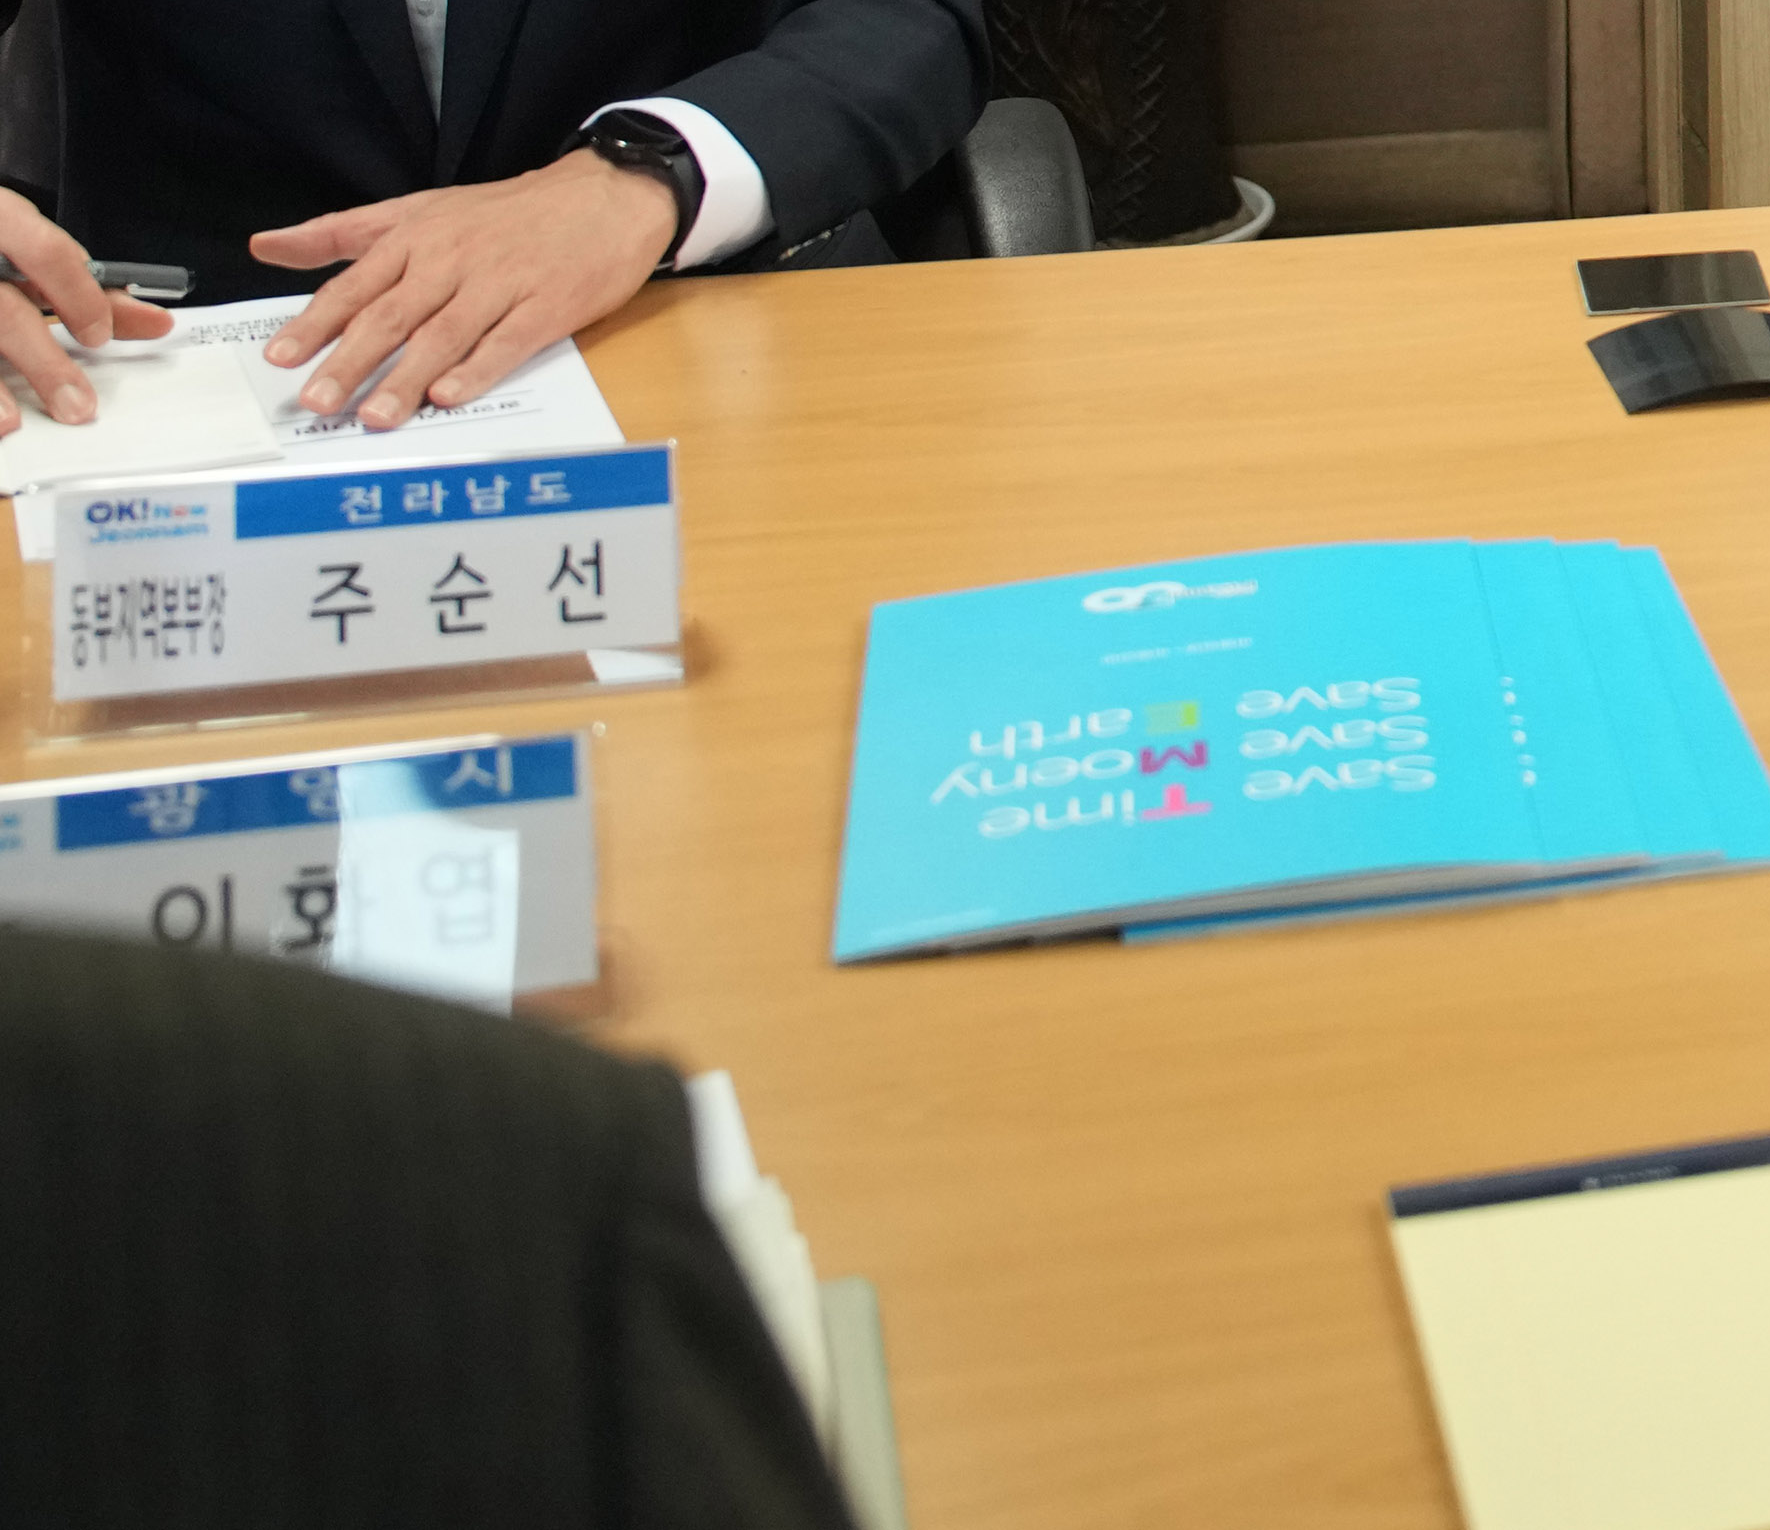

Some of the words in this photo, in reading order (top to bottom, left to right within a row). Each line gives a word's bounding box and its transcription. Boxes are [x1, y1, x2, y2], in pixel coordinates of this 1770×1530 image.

[87, 498, 148, 526] OK!
[340, 470, 573, 527] 전라남도
[308, 539, 607, 645] 주순선
[70, 572, 228, 668] 동부지역본부장
[1235, 676, 1422, 720] Save
[1238, 715, 1429, 760] Save
[1242, 755, 1437, 802] Save
[977, 783, 1213, 839] Time
